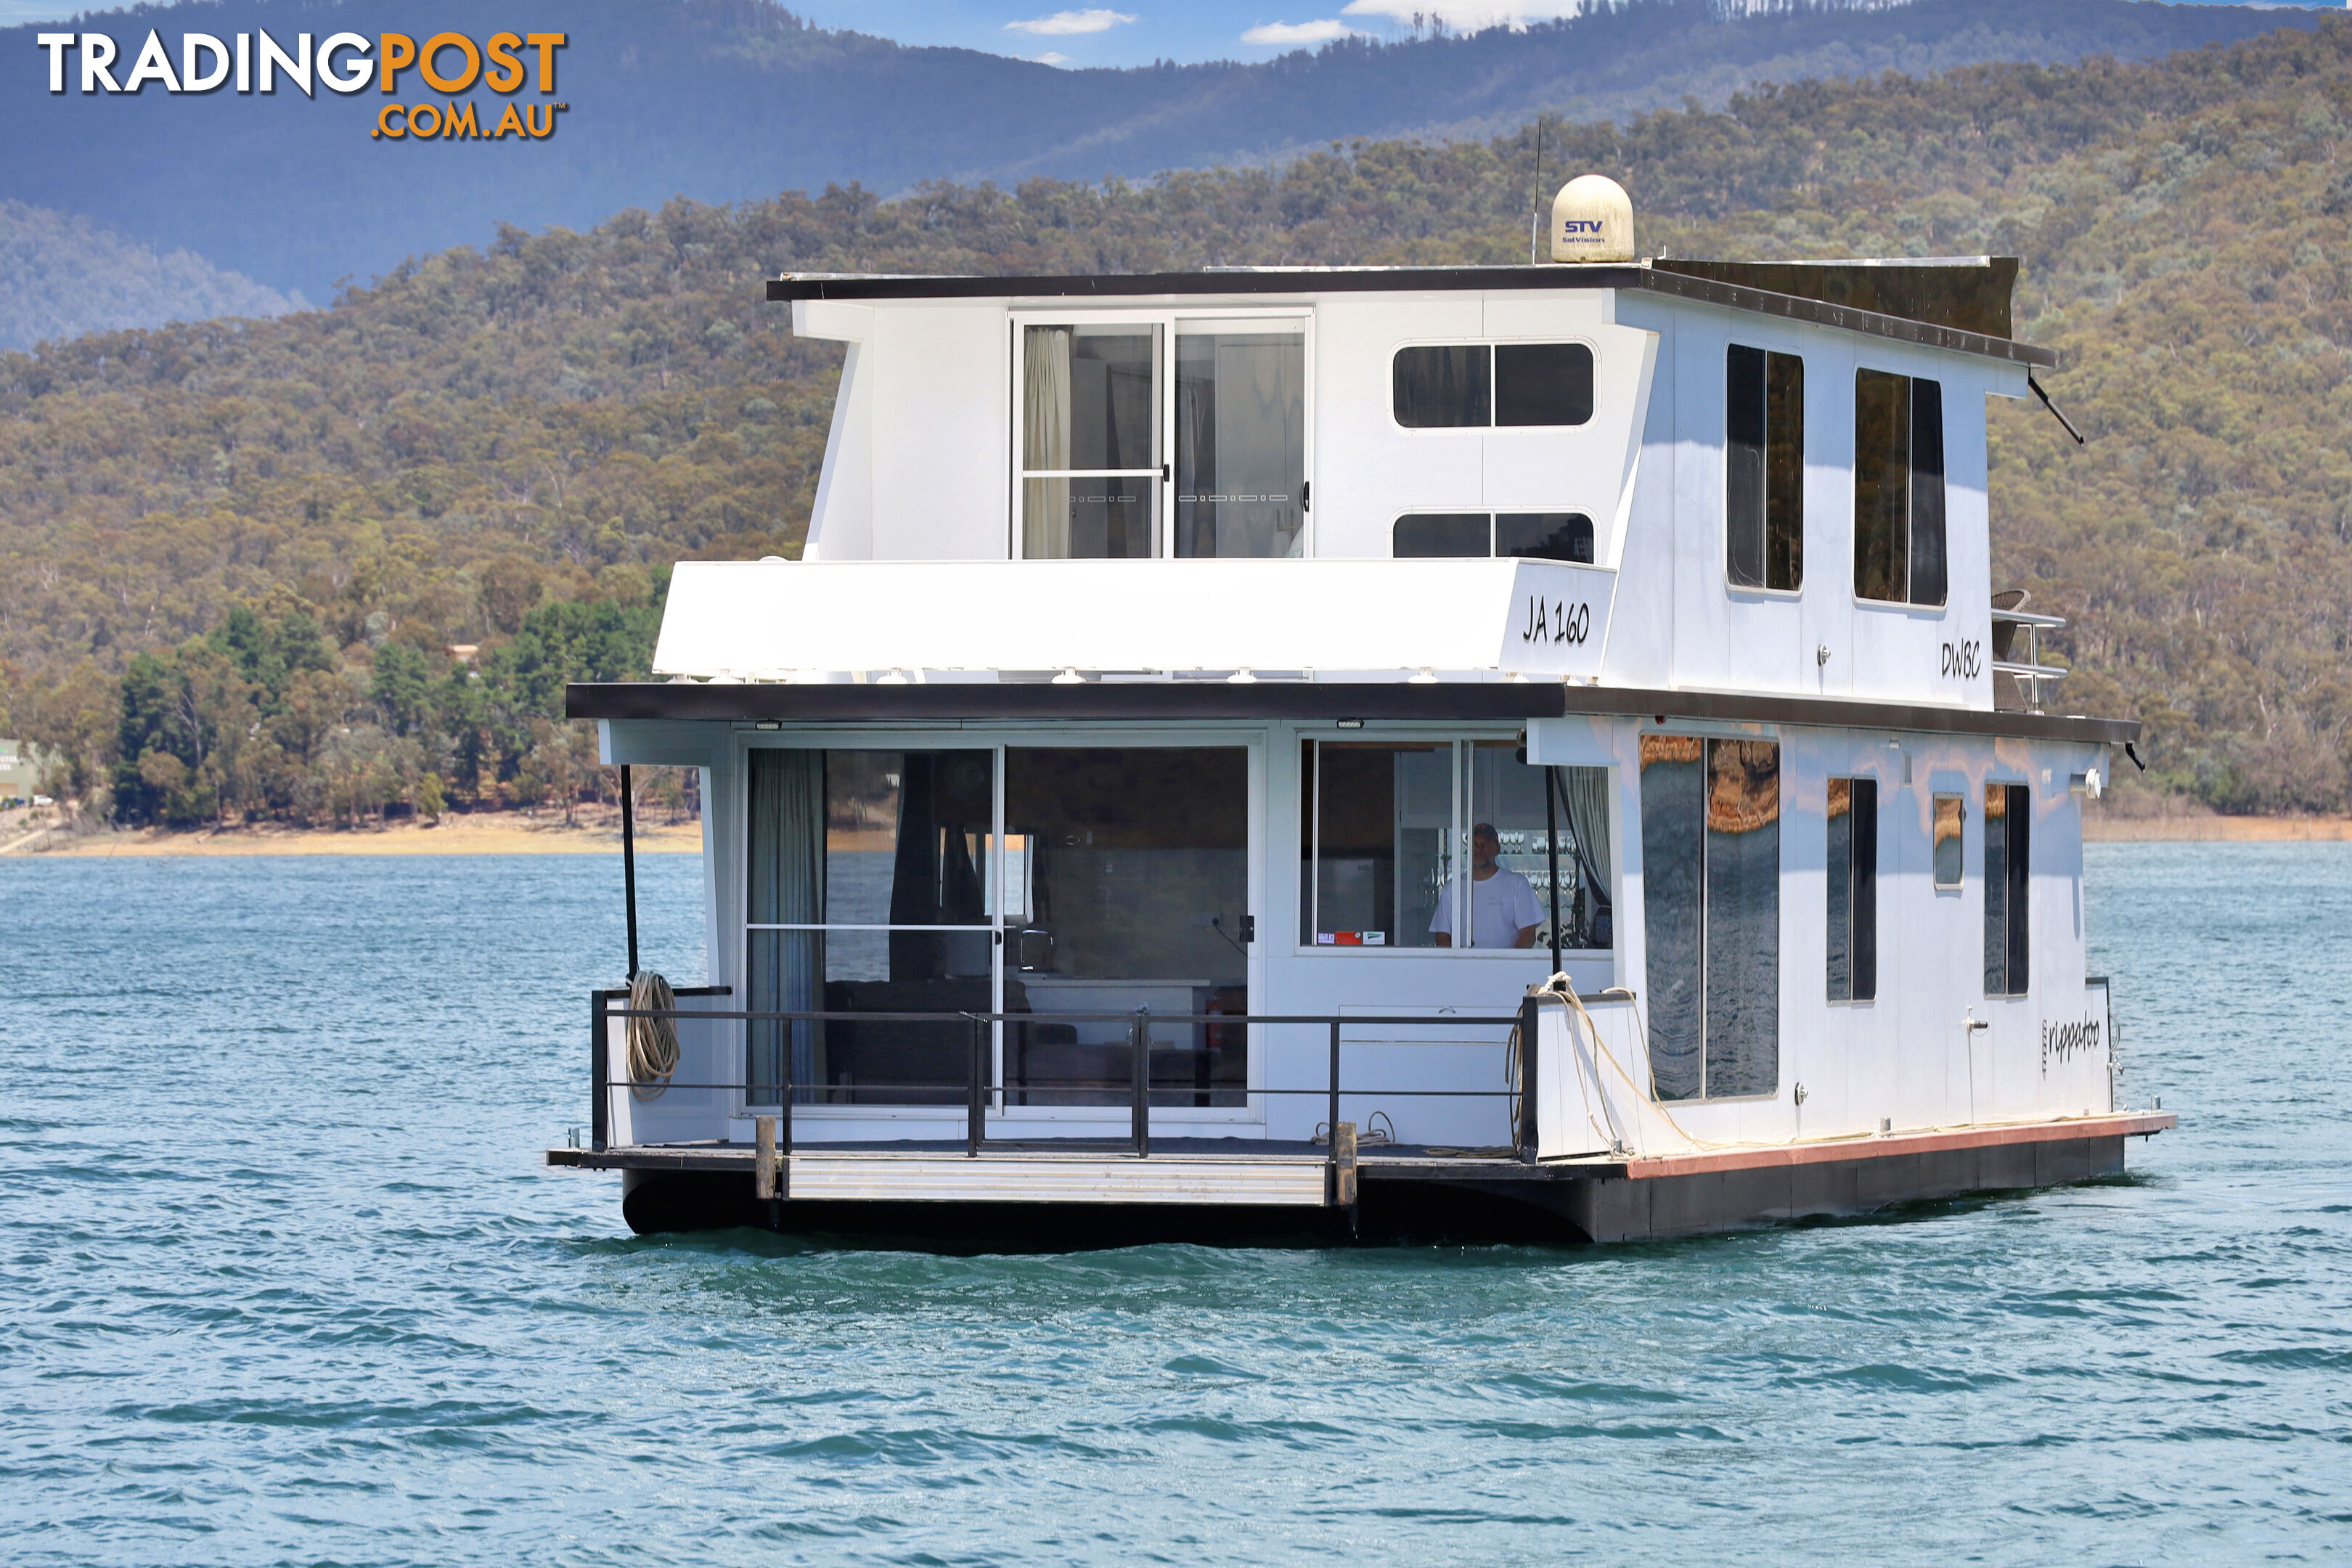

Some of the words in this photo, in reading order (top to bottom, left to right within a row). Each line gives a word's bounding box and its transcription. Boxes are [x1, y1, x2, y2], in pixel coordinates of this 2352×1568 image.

[1565, 221, 1603, 232] STV
[1523, 595, 1548, 643] JA
[1554, 600, 1590, 645] 160
